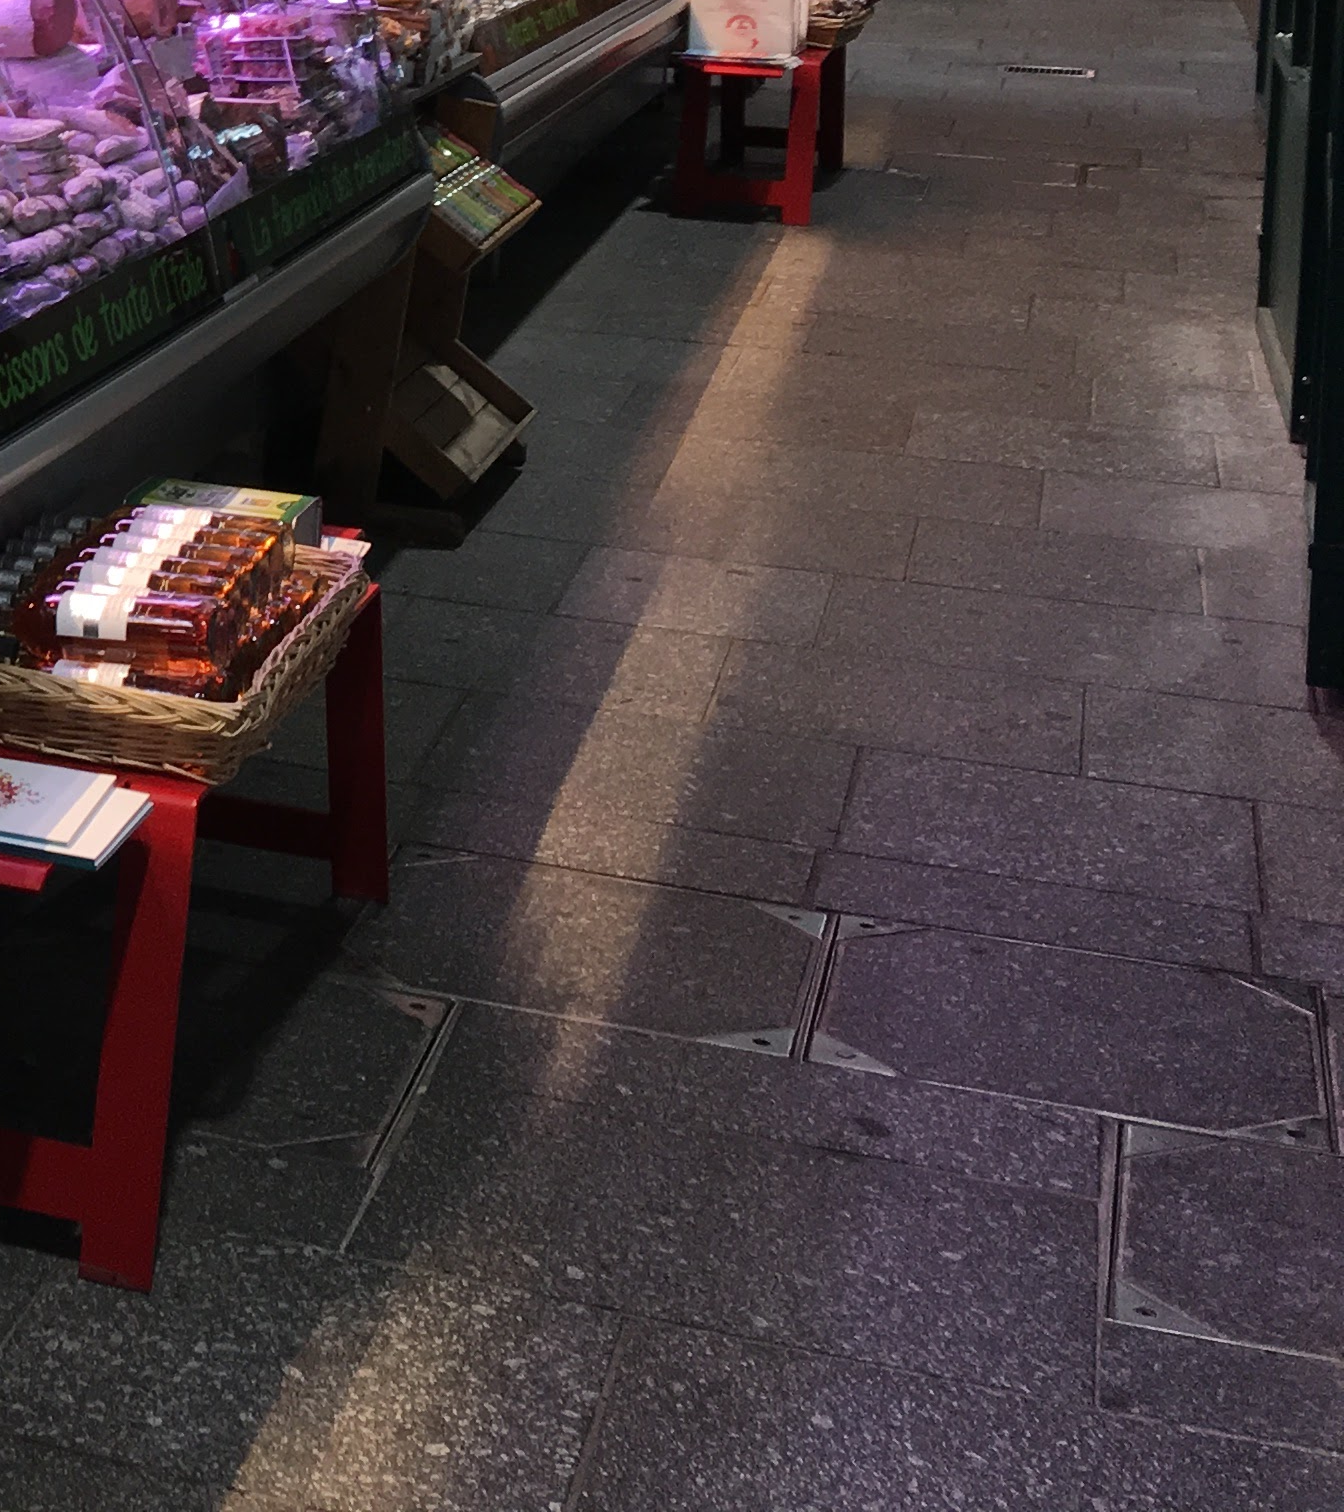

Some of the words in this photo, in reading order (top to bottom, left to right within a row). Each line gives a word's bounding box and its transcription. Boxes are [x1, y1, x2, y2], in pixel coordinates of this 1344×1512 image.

[71, 307, 99, 362] de
[99, 281, 152, 347] toute
[150, 252, 209, 317] l'Italie
